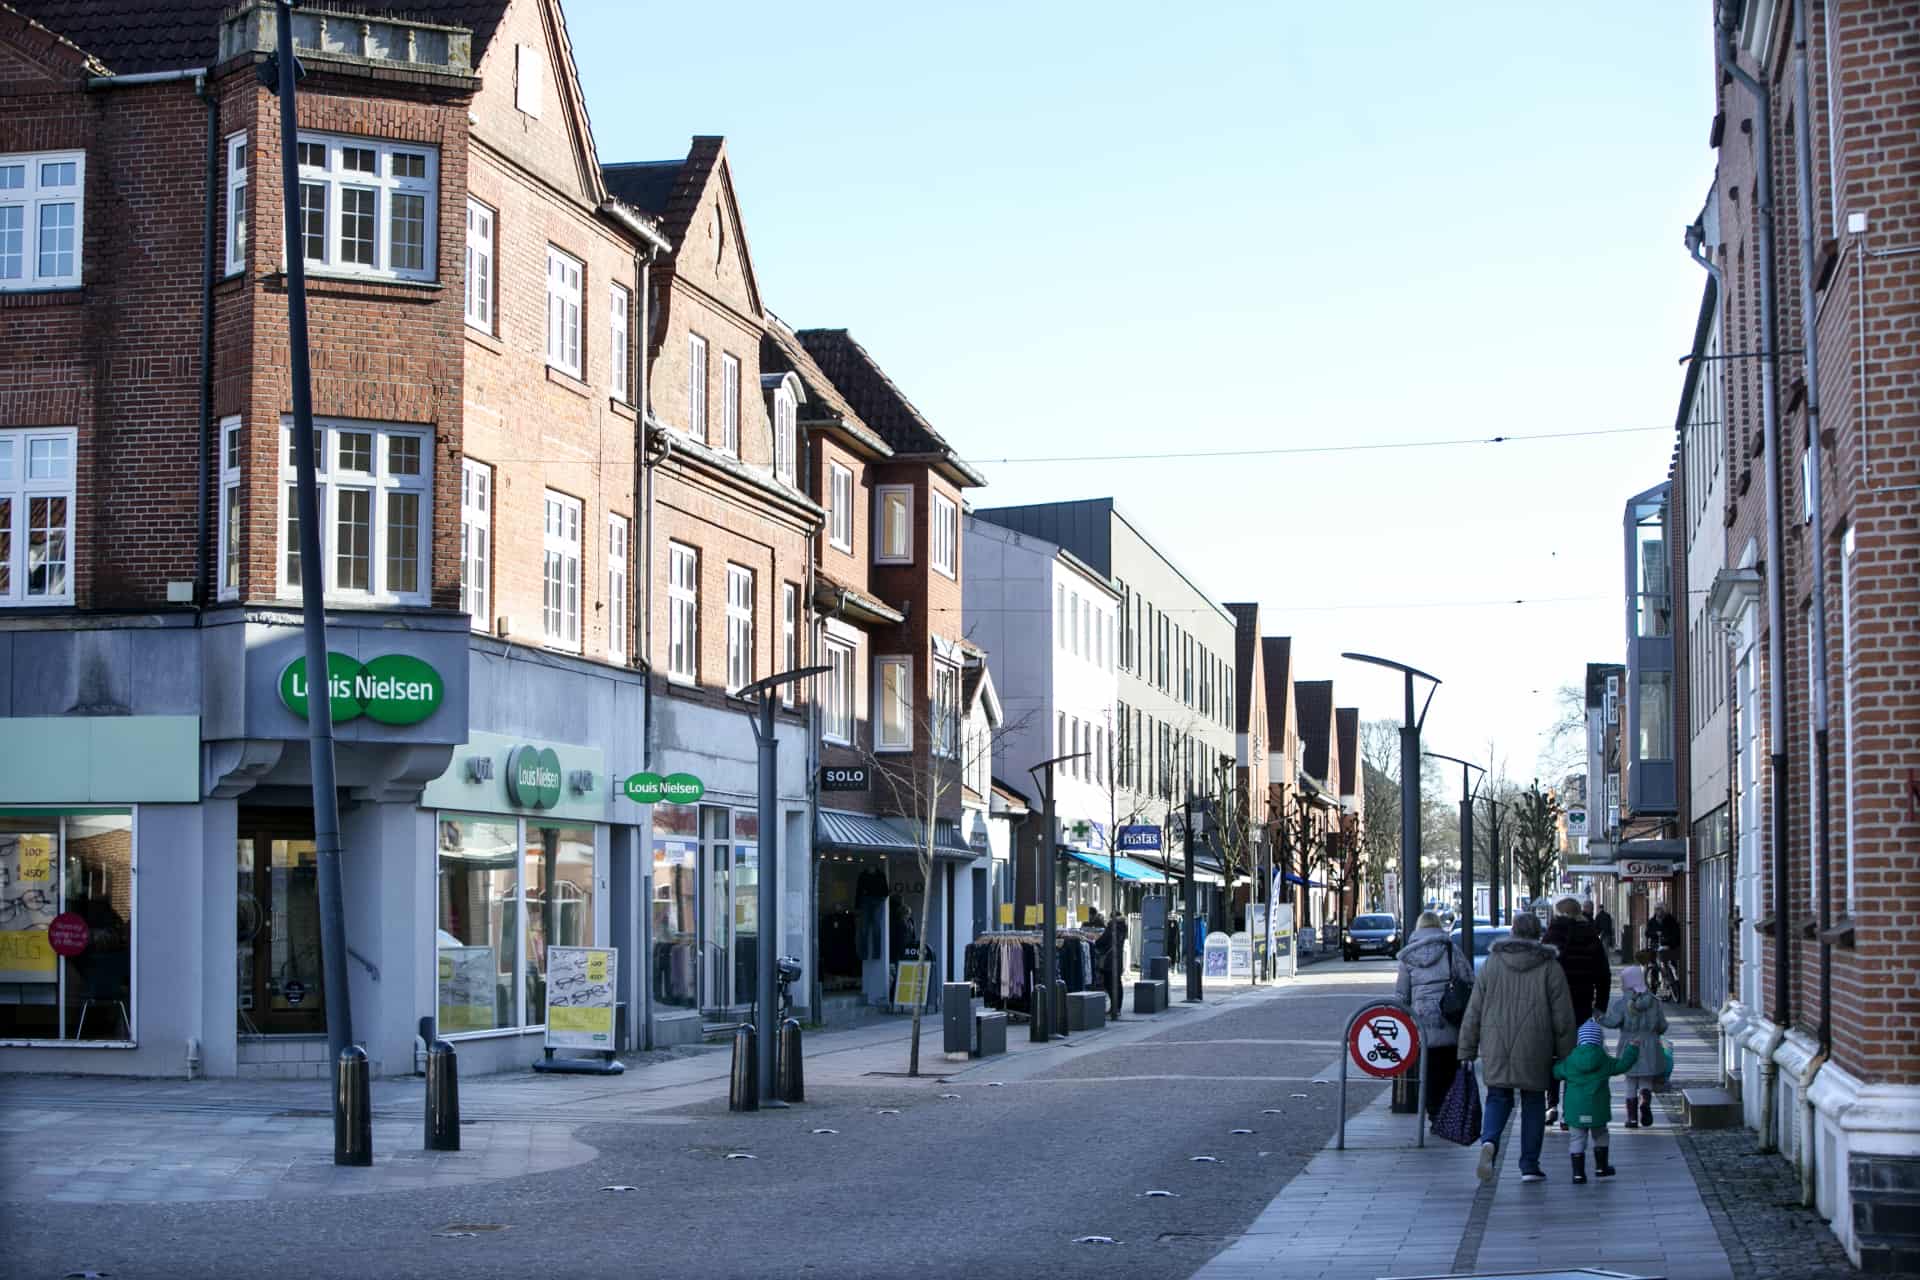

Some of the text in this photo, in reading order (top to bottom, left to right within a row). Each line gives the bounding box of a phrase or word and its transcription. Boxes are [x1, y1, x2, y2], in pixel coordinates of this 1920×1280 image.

[292, 673, 433, 701] Lis Nielsen
[519, 764, 536, 787] Louis
[535, 766, 559, 788] Nielsen
[826, 770, 864, 782] SOLO
[628, 781, 699, 794] Louis Nielsen
[1123, 831, 1158, 845] matas
